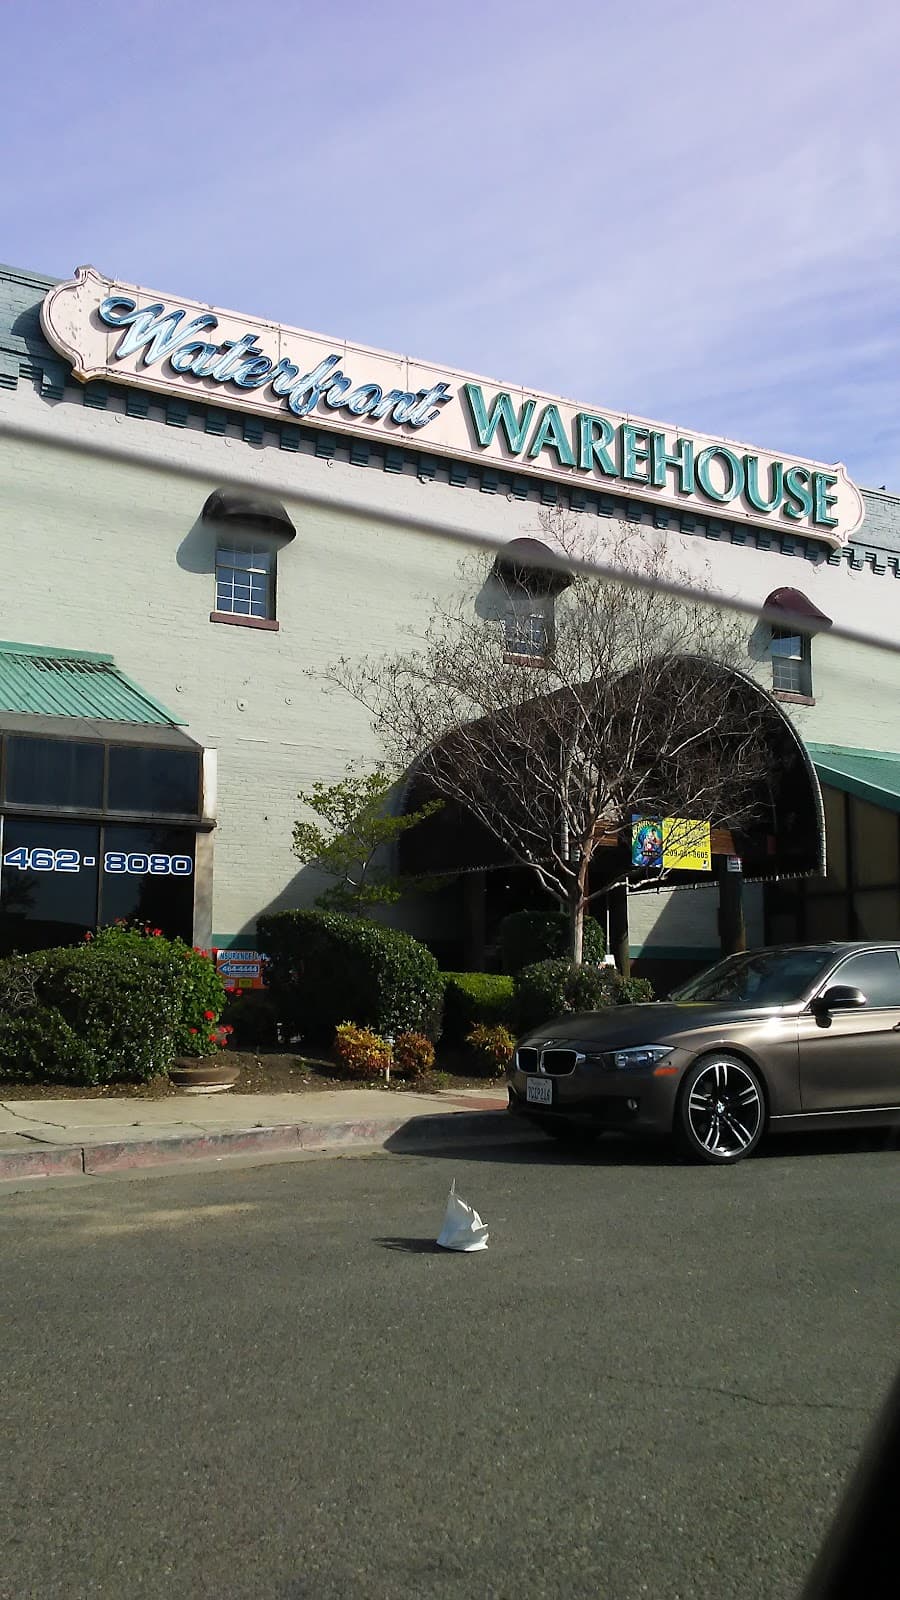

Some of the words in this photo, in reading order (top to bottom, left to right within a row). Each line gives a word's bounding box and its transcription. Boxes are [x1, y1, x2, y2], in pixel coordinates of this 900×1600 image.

[98, 296, 453, 428] Waterfront
[463, 382, 840, 528] WAREHOUSE
[218, 951, 252, 961] NSURANCE
